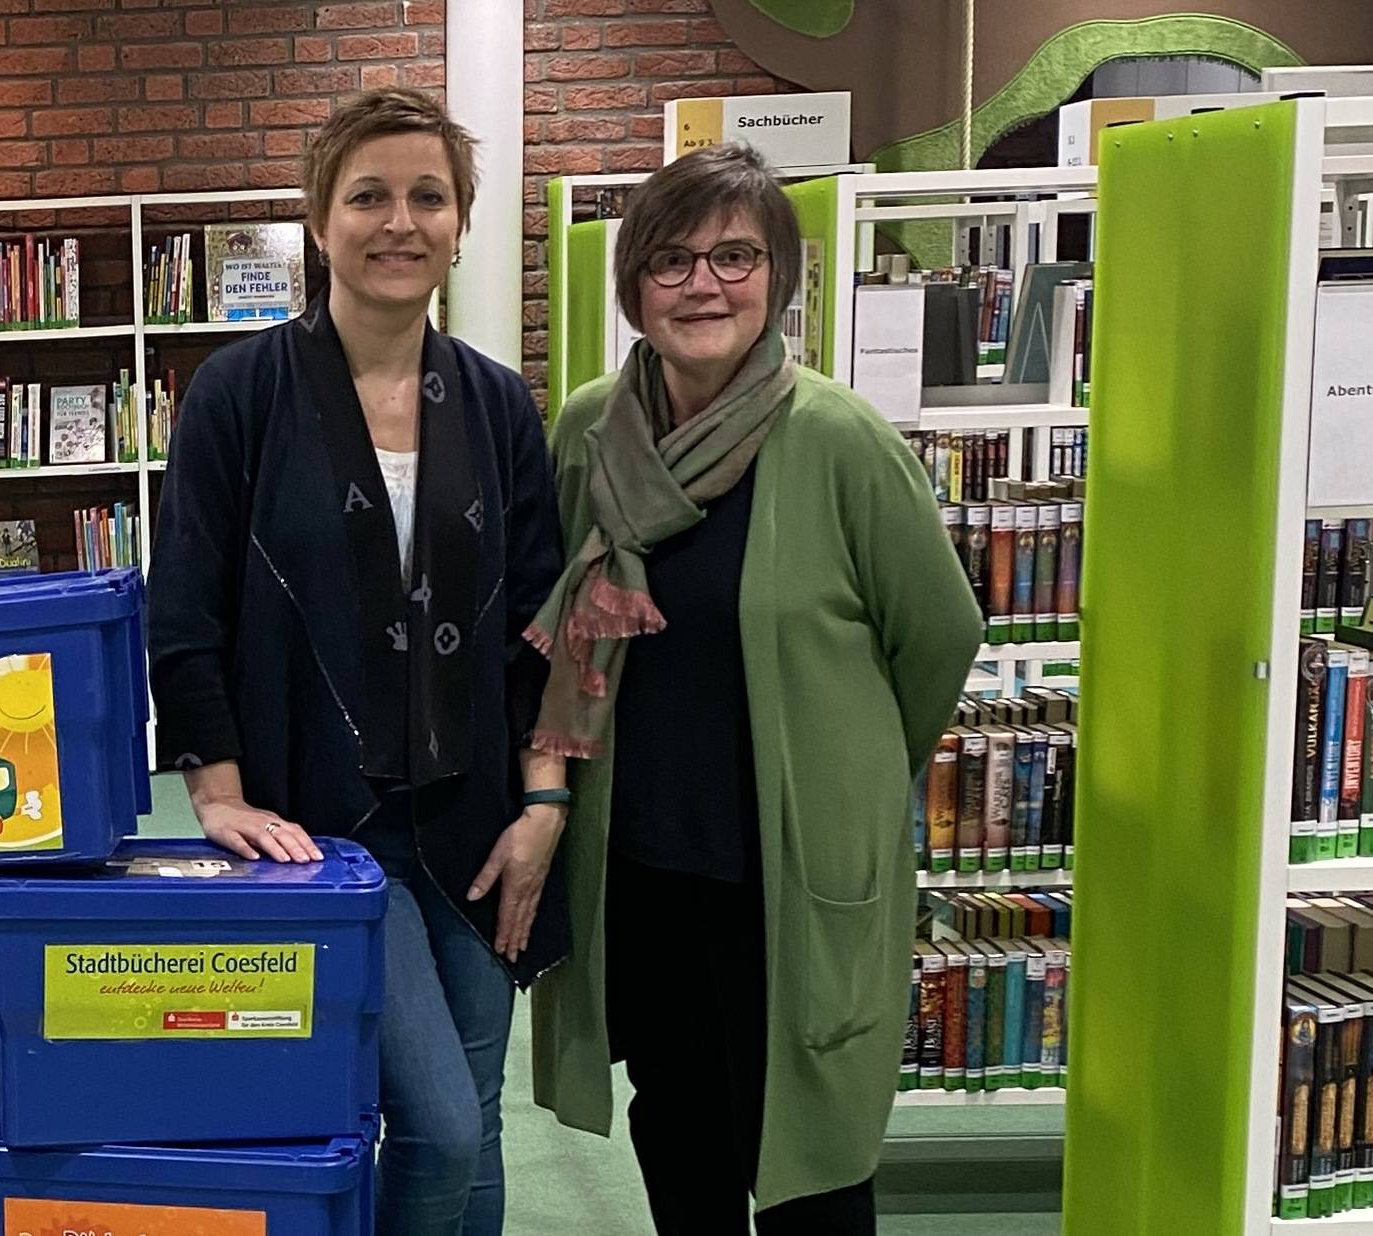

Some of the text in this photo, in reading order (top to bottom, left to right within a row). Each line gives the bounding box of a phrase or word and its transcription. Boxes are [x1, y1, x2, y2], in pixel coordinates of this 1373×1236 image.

[737, 114, 824, 128] Sachbücher
[683, 123, 690, 132] 6
[683, 139, 696, 148] Ab
[241, 272, 271, 282] FINDE
[225, 282, 288, 294] DEN FEHLER
[57, 396, 87, 406] PARTY
[1344, 739, 1362, 790] INVENTORY
[65, 952, 298, 974] Stadtbücherei Coesfeld
[99, 978, 265, 994] entdecke neue Welten!
